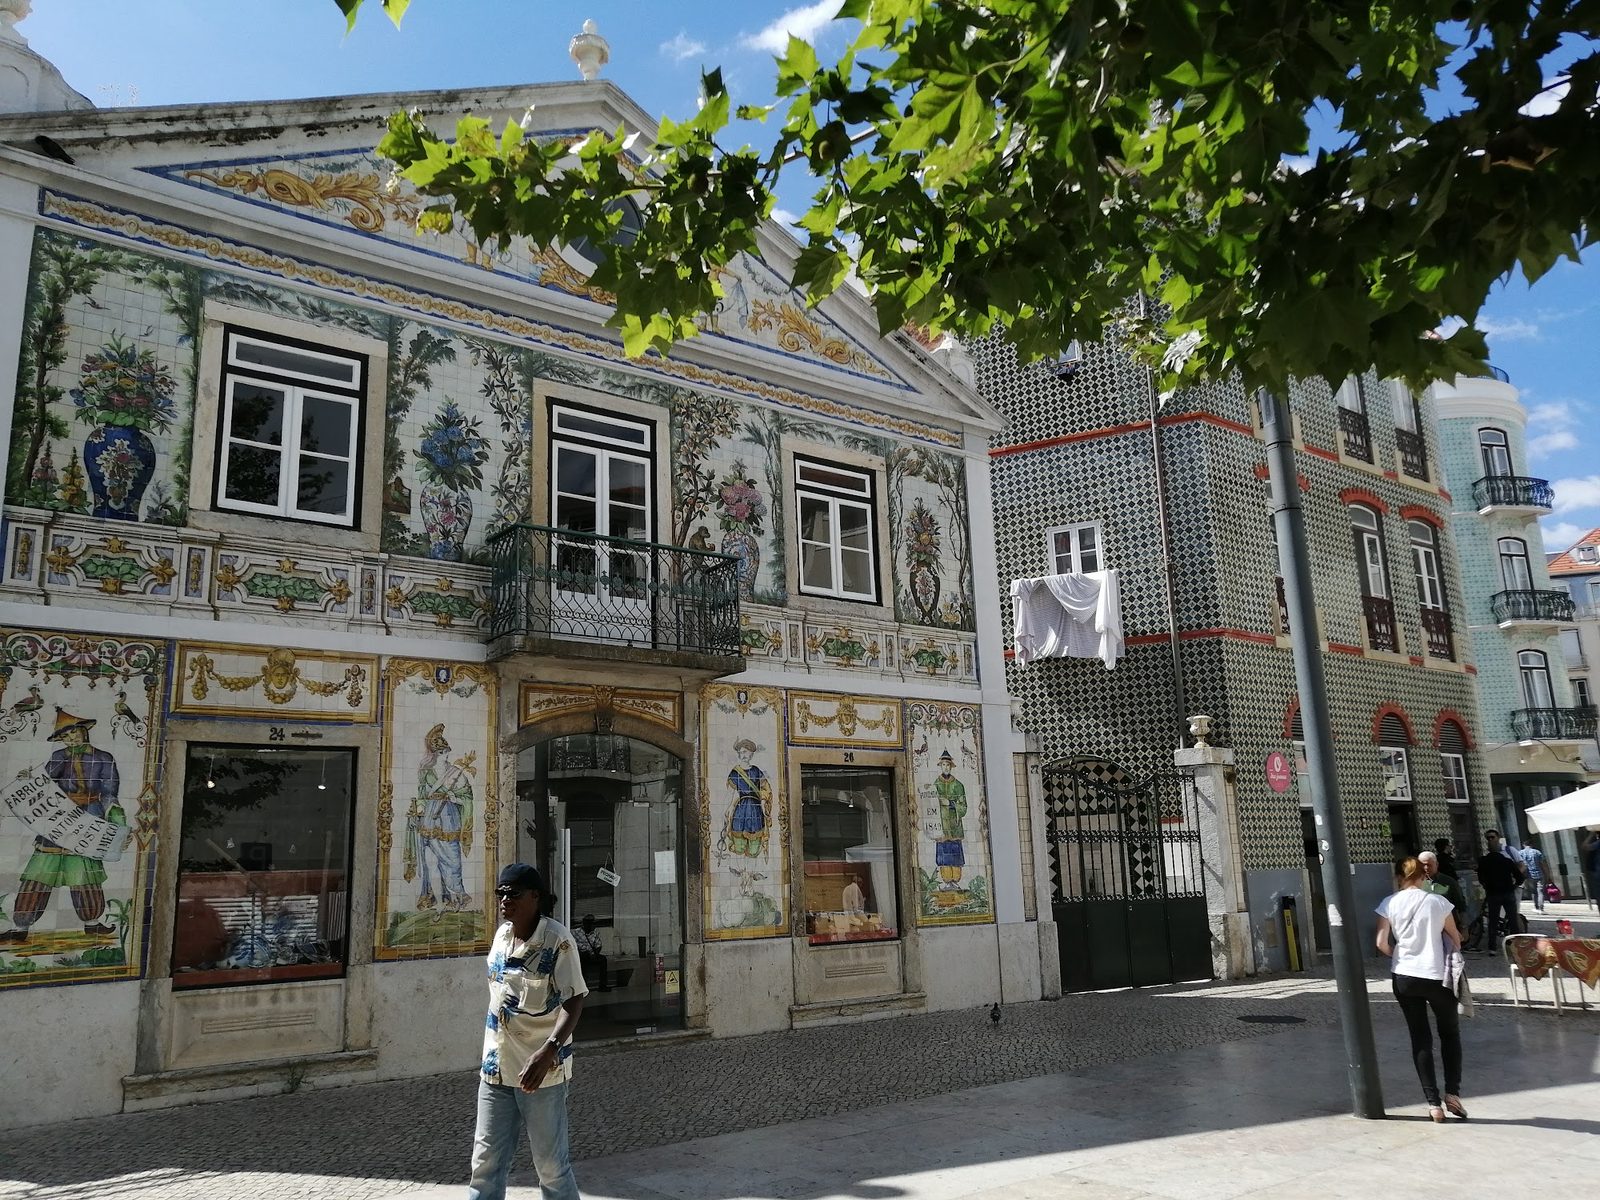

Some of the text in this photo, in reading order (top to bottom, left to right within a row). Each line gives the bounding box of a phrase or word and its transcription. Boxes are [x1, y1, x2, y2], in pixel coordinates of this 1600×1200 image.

[269, 727, 285, 741] 24
[843, 752, 854, 762] 26
[28, 790, 45, 806] DE
[24, 791, 67, 824] LOIÇA
[926, 807, 938, 816] EM
[48, 809, 66, 823] DE
[49, 806, 86, 841] ANTONIO
[74, 818, 105, 855] COSTA
